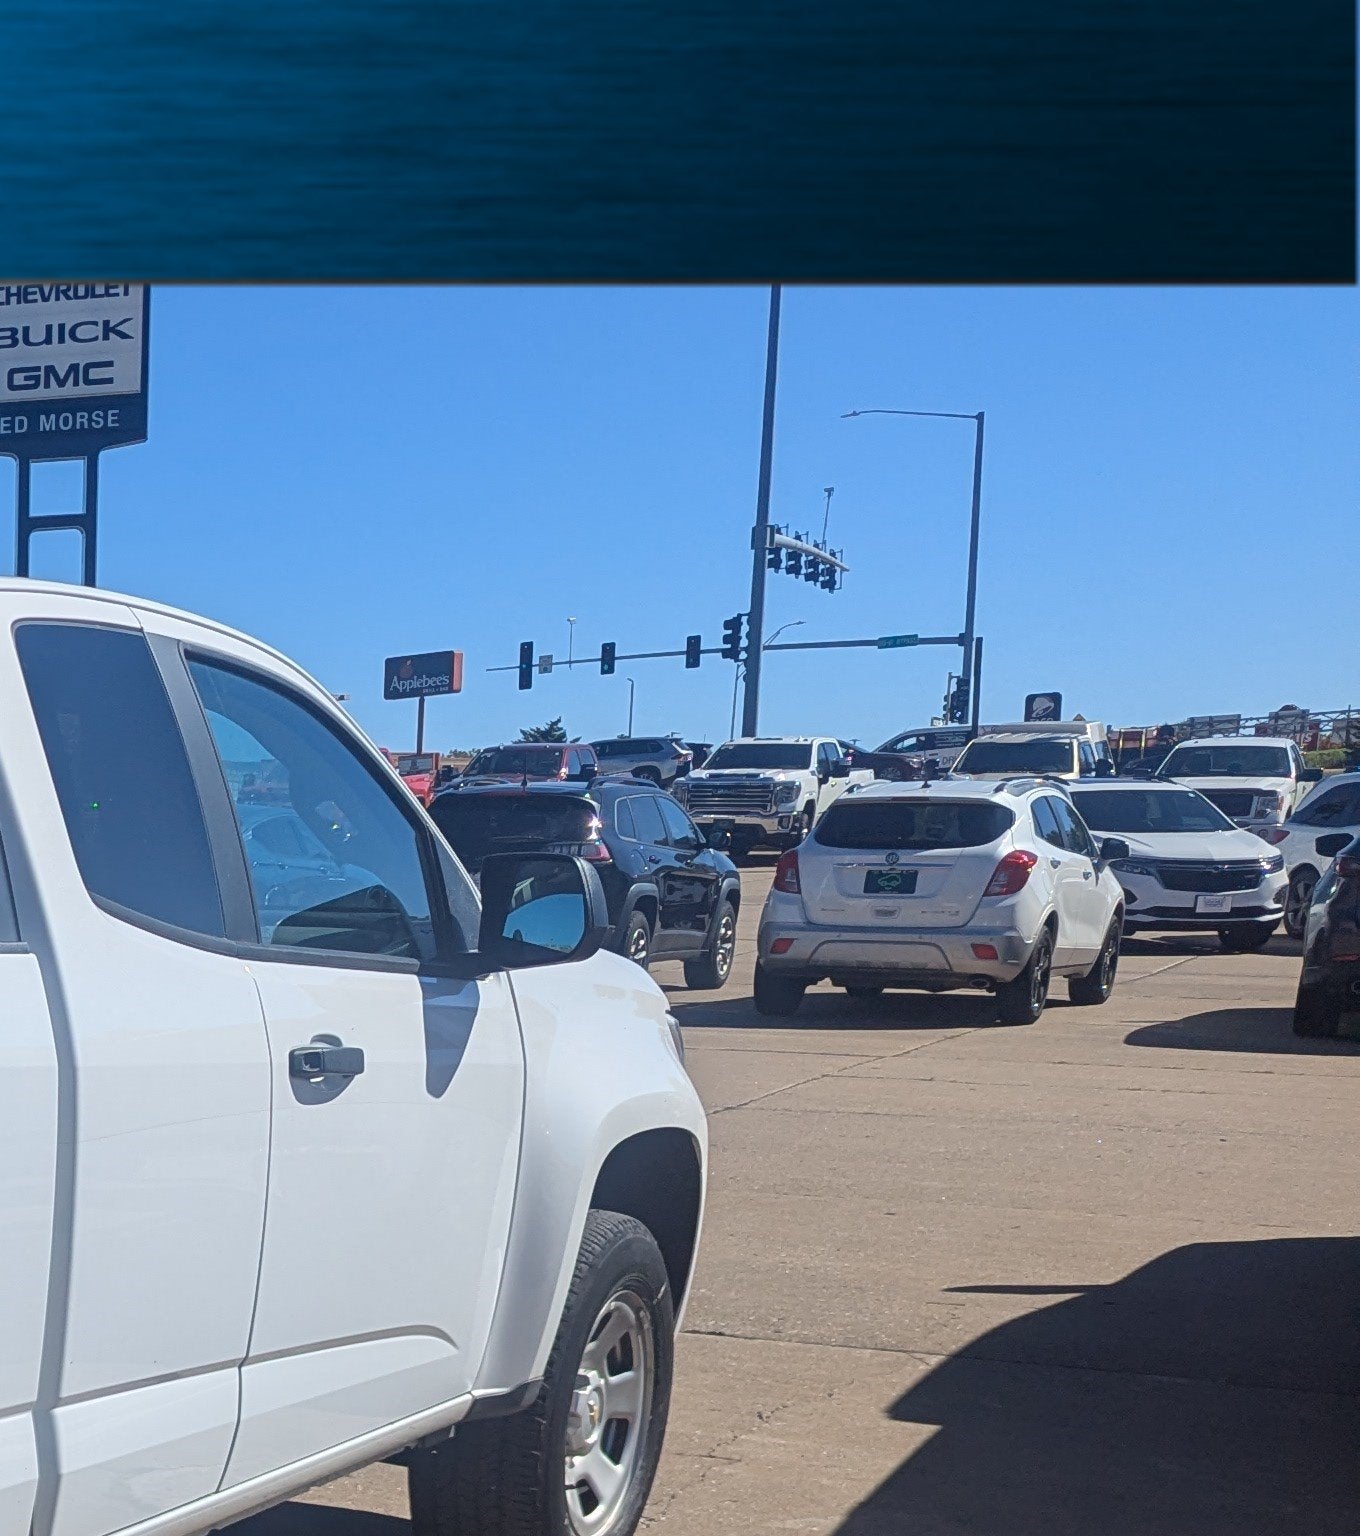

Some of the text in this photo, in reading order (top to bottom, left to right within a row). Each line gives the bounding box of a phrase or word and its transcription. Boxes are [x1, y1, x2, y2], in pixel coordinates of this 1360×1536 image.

[6, 361, 114, 391] GMC
[0, 409, 120, 434] ED MORSE
[389, 674, 450, 692] Applebee's
